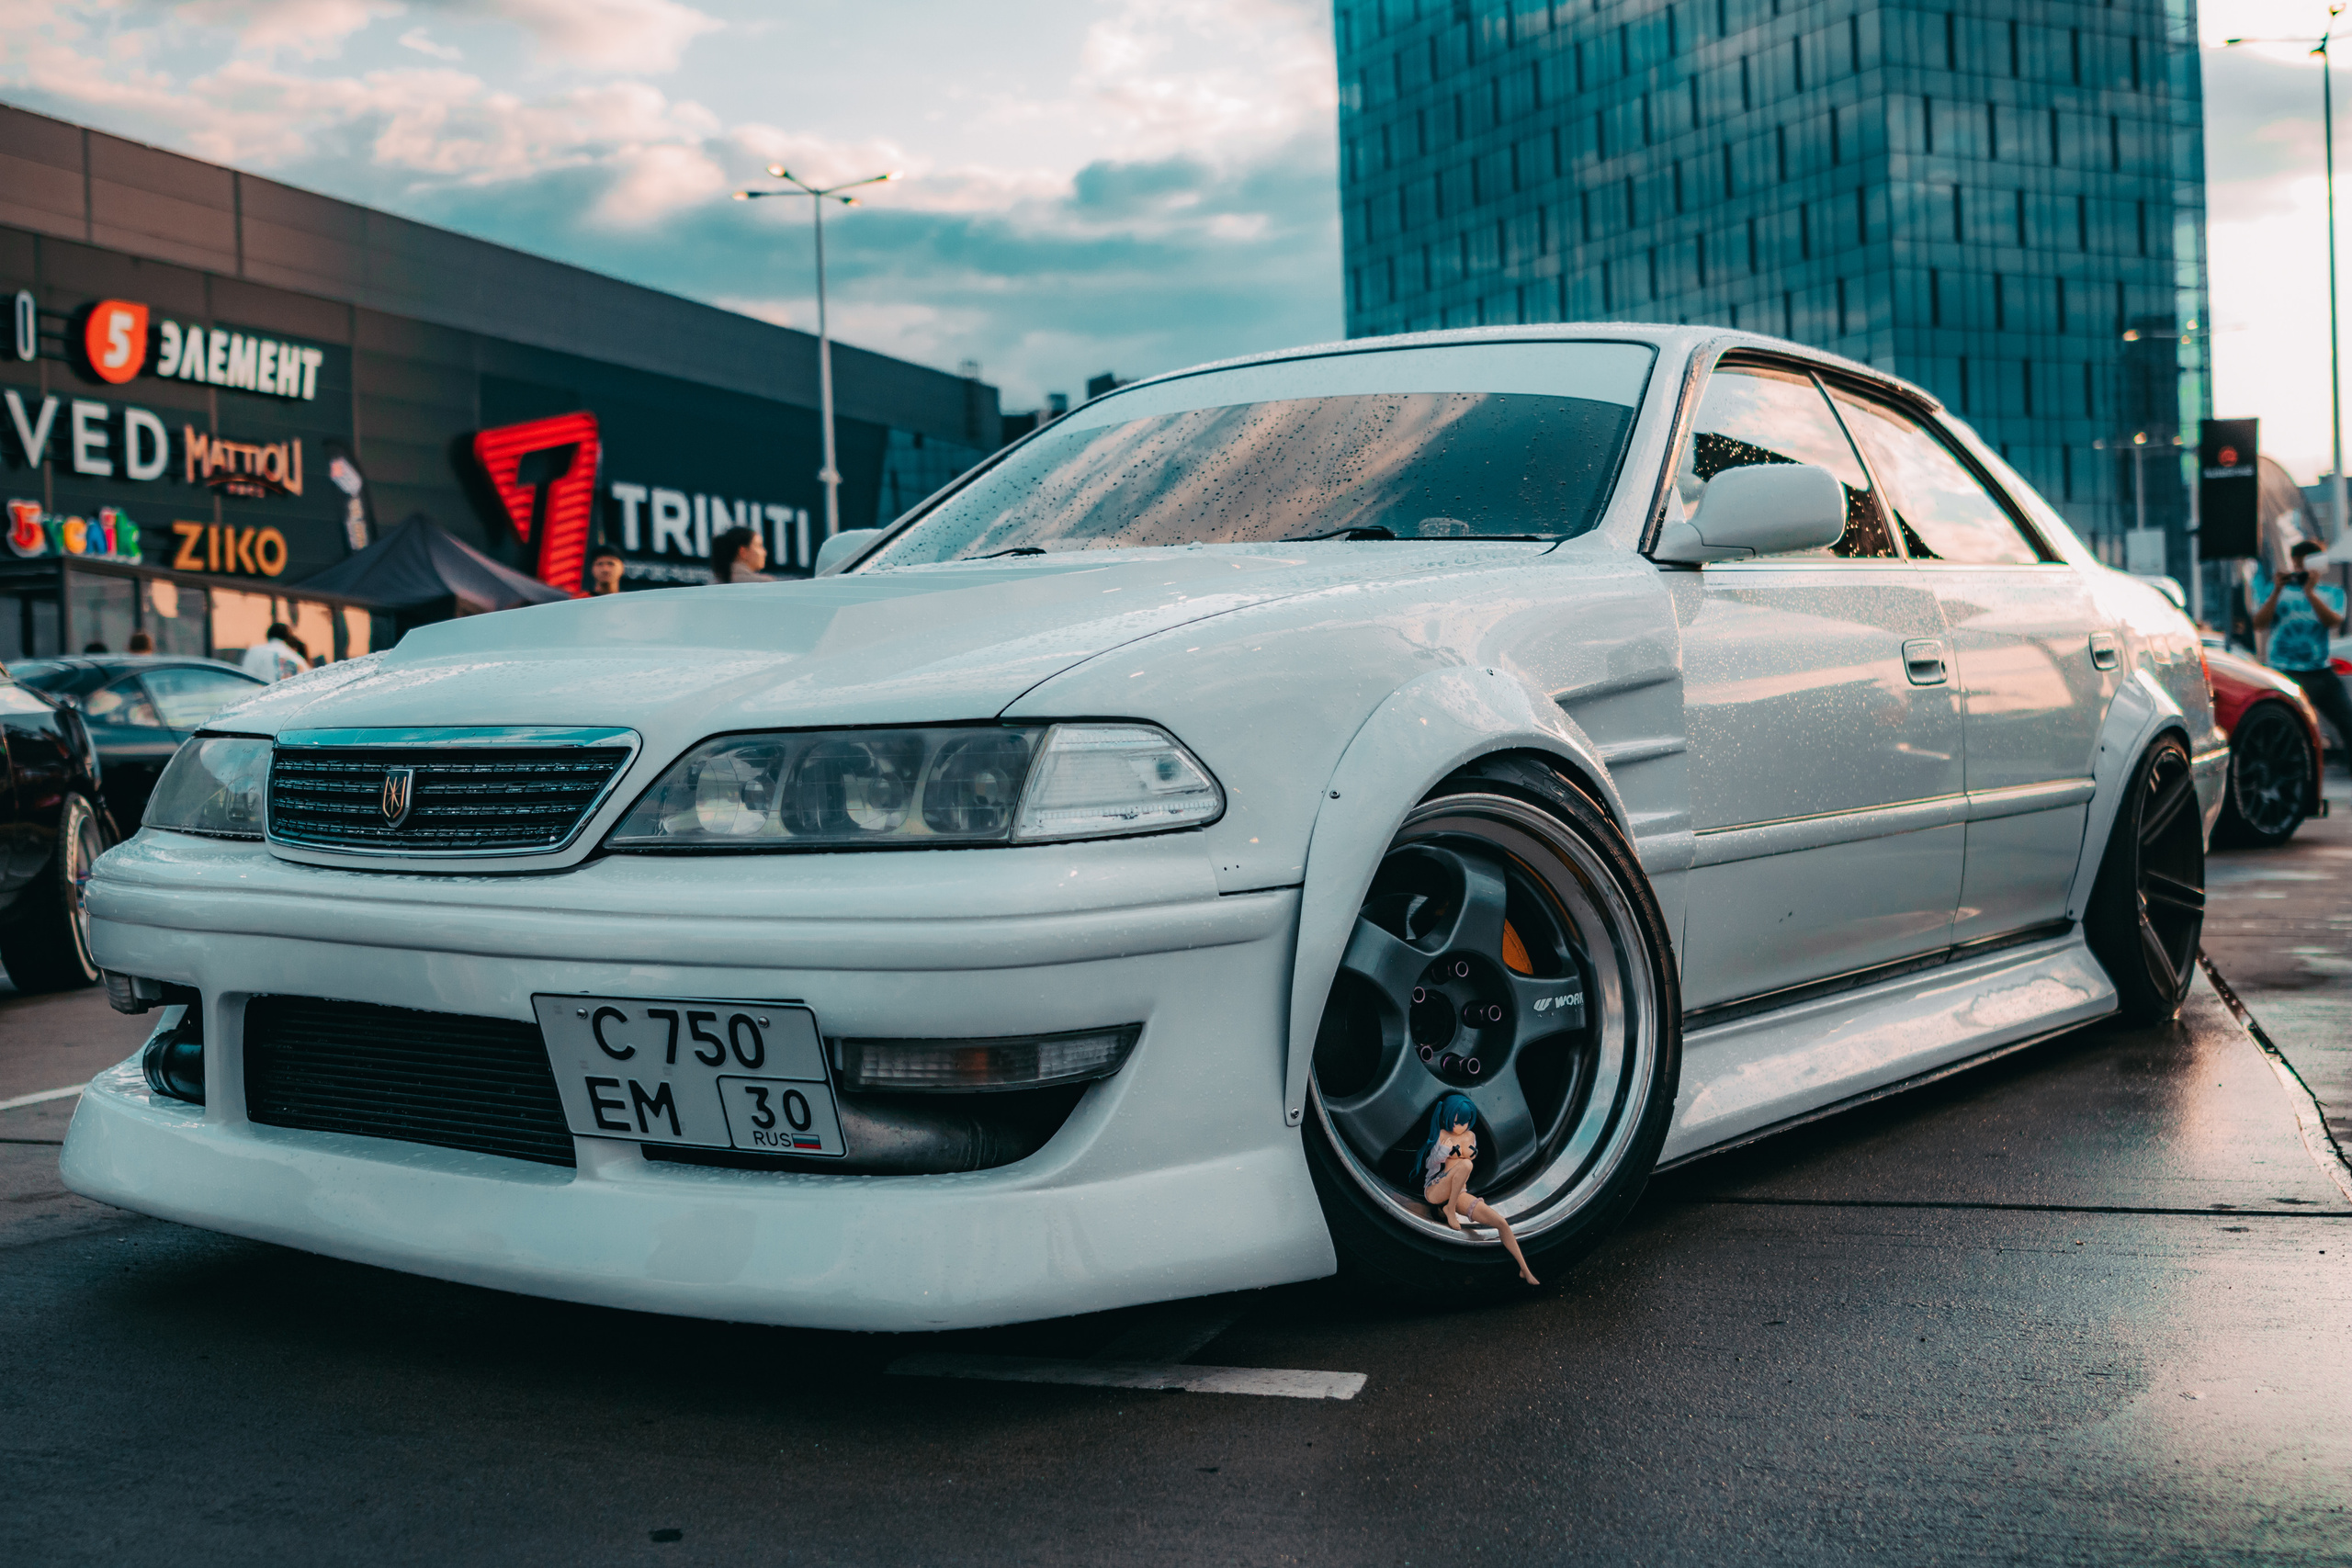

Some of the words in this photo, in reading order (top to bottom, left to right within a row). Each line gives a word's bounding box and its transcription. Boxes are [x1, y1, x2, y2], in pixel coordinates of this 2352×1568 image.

[103, 310, 135, 368] 5
[157, 320, 323, 400] ЭЛЕМЕНТ
[4, 389, 170, 481] VED
[172, 520, 288, 577] ZIKO
[1555, 991, 1584, 1009] WORK
[584, 1076, 682, 1136] EM
[745, 1086, 812, 1132] 30
[752, 1130, 792, 1147] RUS
